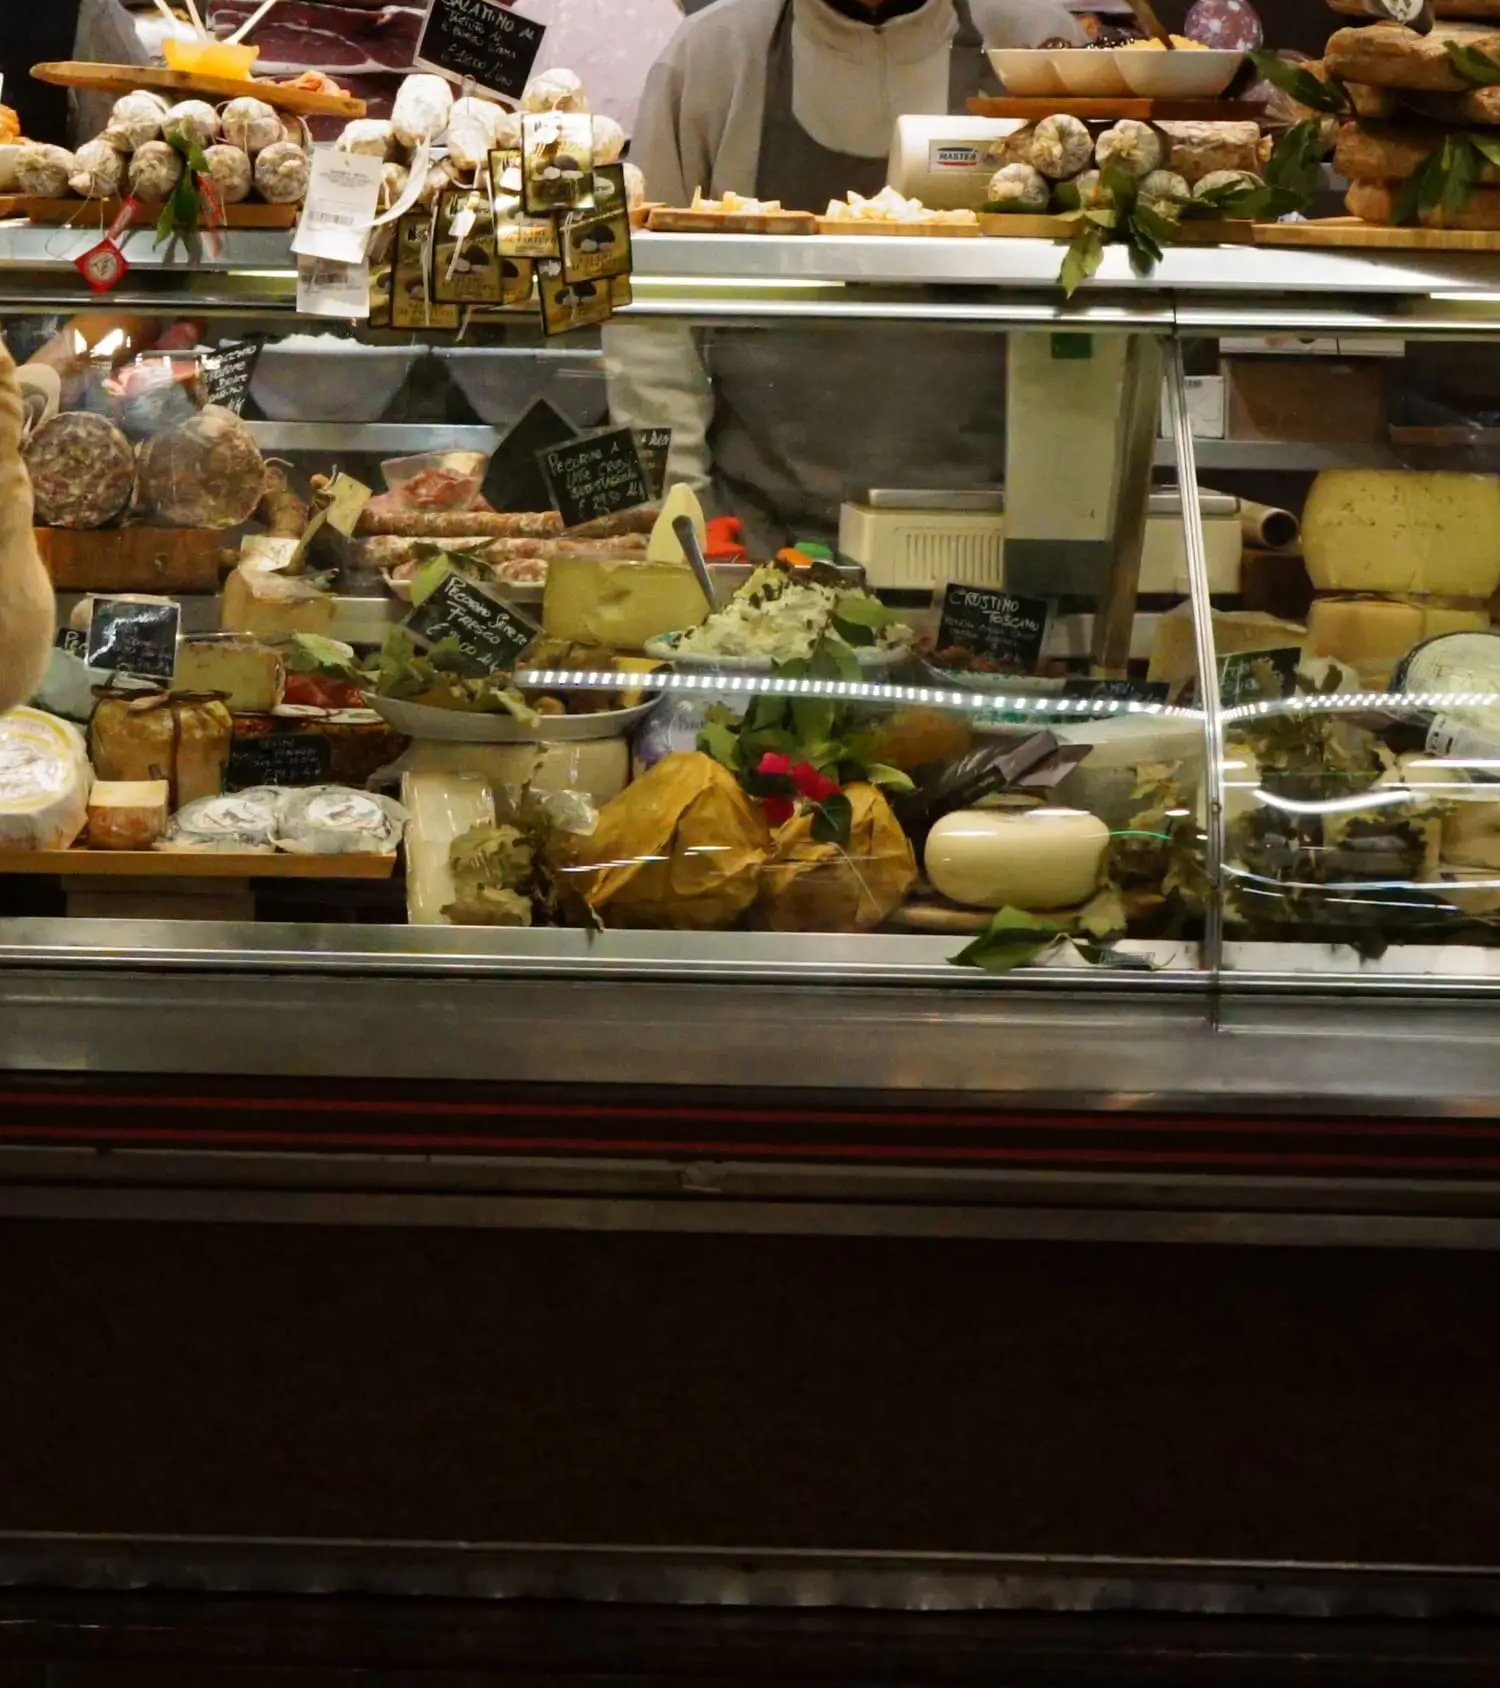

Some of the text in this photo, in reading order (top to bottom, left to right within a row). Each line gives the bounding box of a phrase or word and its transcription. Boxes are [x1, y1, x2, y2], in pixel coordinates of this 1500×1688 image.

[938, 152, 978, 162] MASTER
[949, 589, 1020, 613] CROSTINO
[981, 610, 1040, 632] TOSCANO
